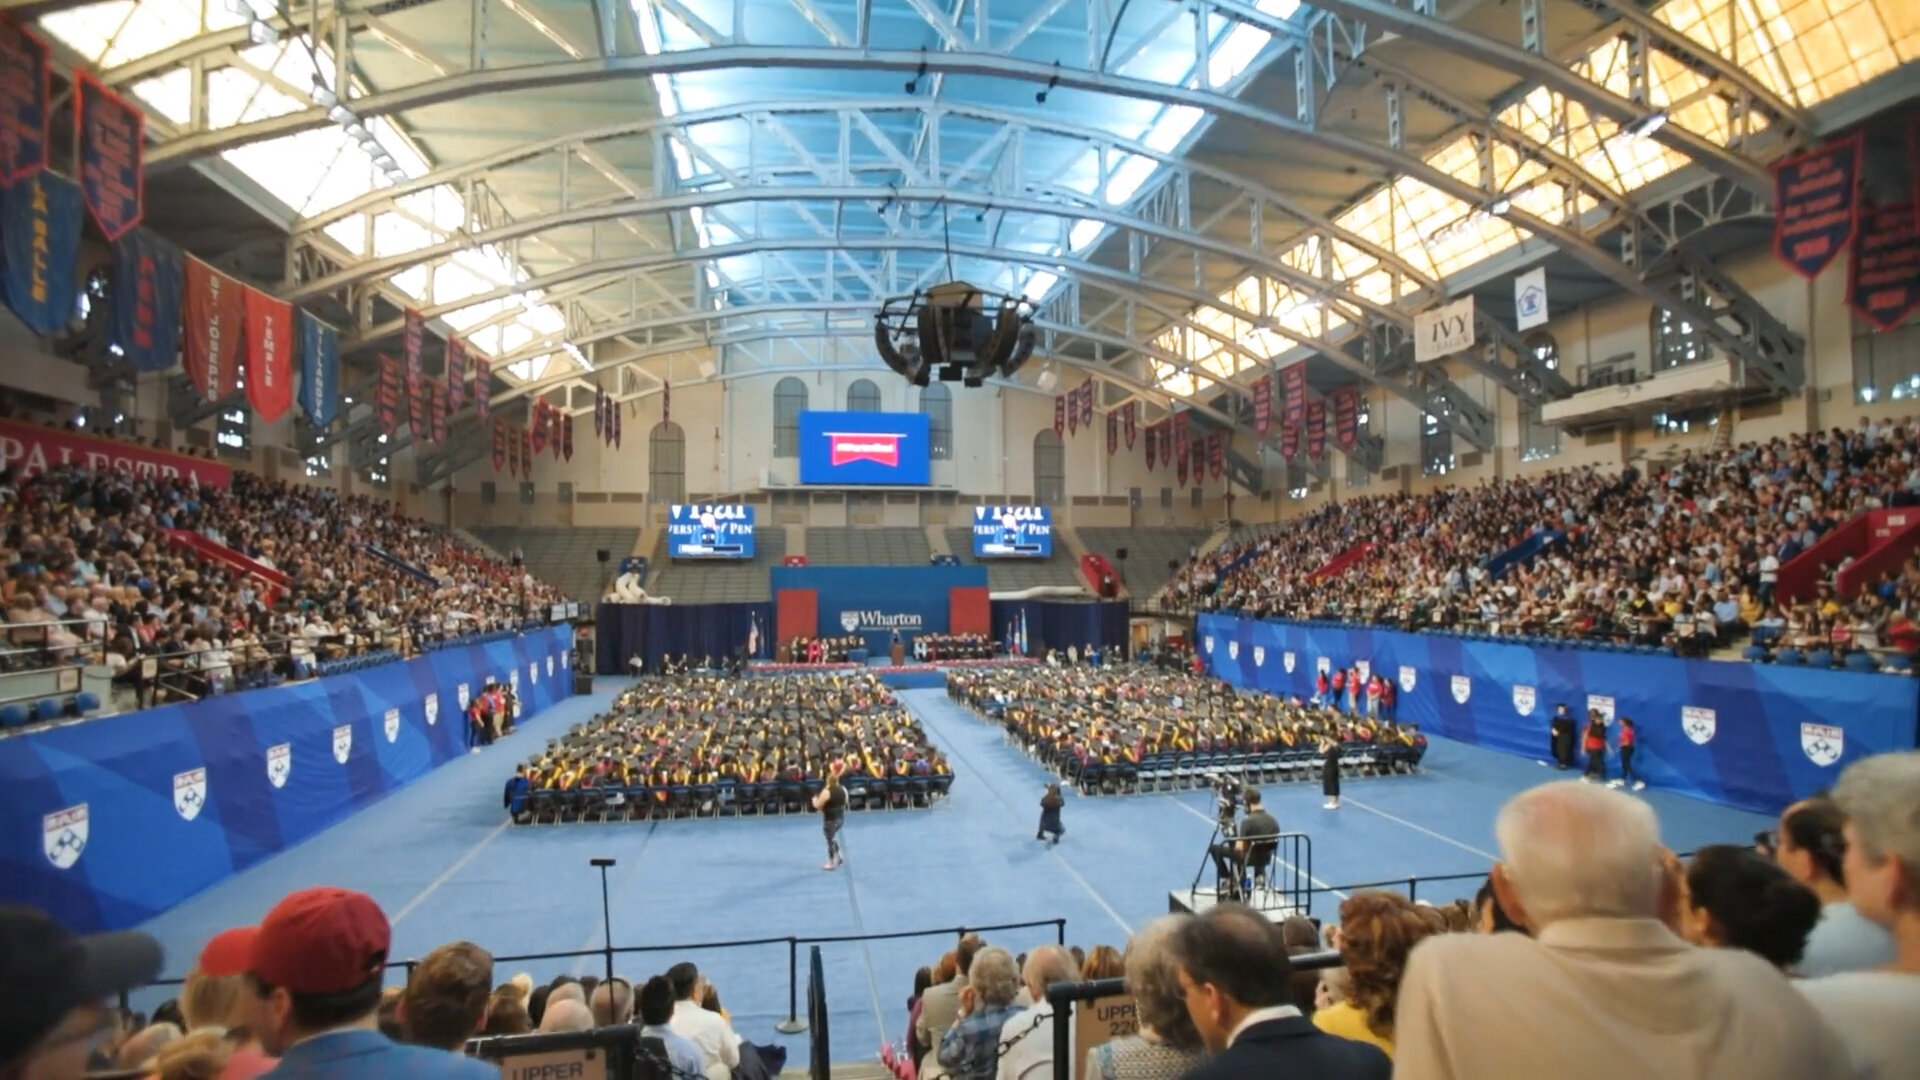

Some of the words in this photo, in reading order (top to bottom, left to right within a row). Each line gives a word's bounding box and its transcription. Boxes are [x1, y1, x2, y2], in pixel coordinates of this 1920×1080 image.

[1432, 312, 1469, 342] IVY
[263, 315, 275, 388] TEMPLE
[314, 324, 324, 419] VILLANOVA
[860, 609, 922, 626] Wharton
[512, 1061, 584, 1080] UPPER
